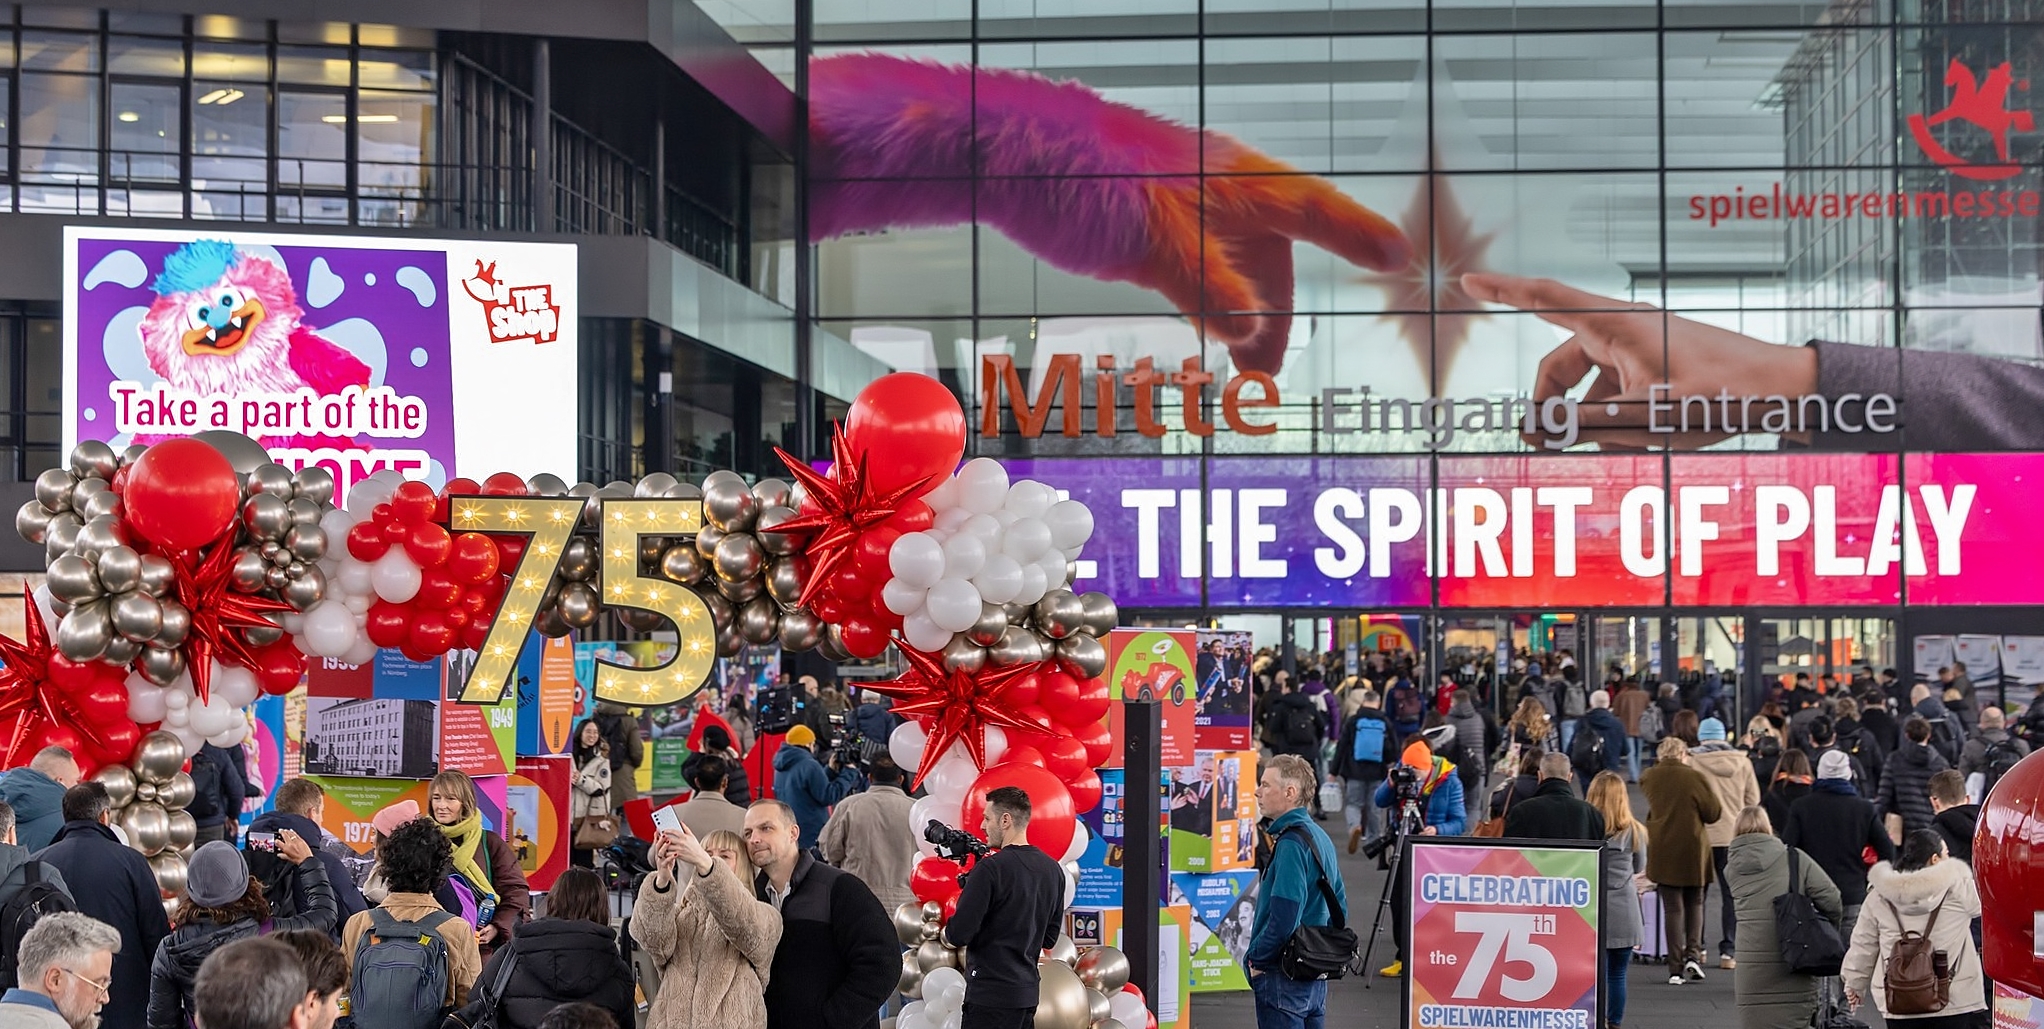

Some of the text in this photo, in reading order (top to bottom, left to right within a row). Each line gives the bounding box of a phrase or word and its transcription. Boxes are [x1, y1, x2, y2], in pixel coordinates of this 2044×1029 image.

[1689, 182, 2040, 227] spielwarenmesse
[116, 388, 420, 435] Take a part of the
[981, 353, 1281, 438] Mitte
[1322, 383, 1898, 450] Eingang Entrance
[1121, 488, 1288, 579] THE
[1312, 486, 1593, 579] SPIRIT
[1618, 484, 1731, 578] OF
[1754, 484, 1978, 577] PLAY
[449, 494, 717, 707] 75
[490, 707, 514, 728] 1949
[1422, 875, 1589, 906] CELEBRATING
[1430, 951, 1457, 965] the
[1421, 1007, 1588, 1029] SPIELWARENMESSE
